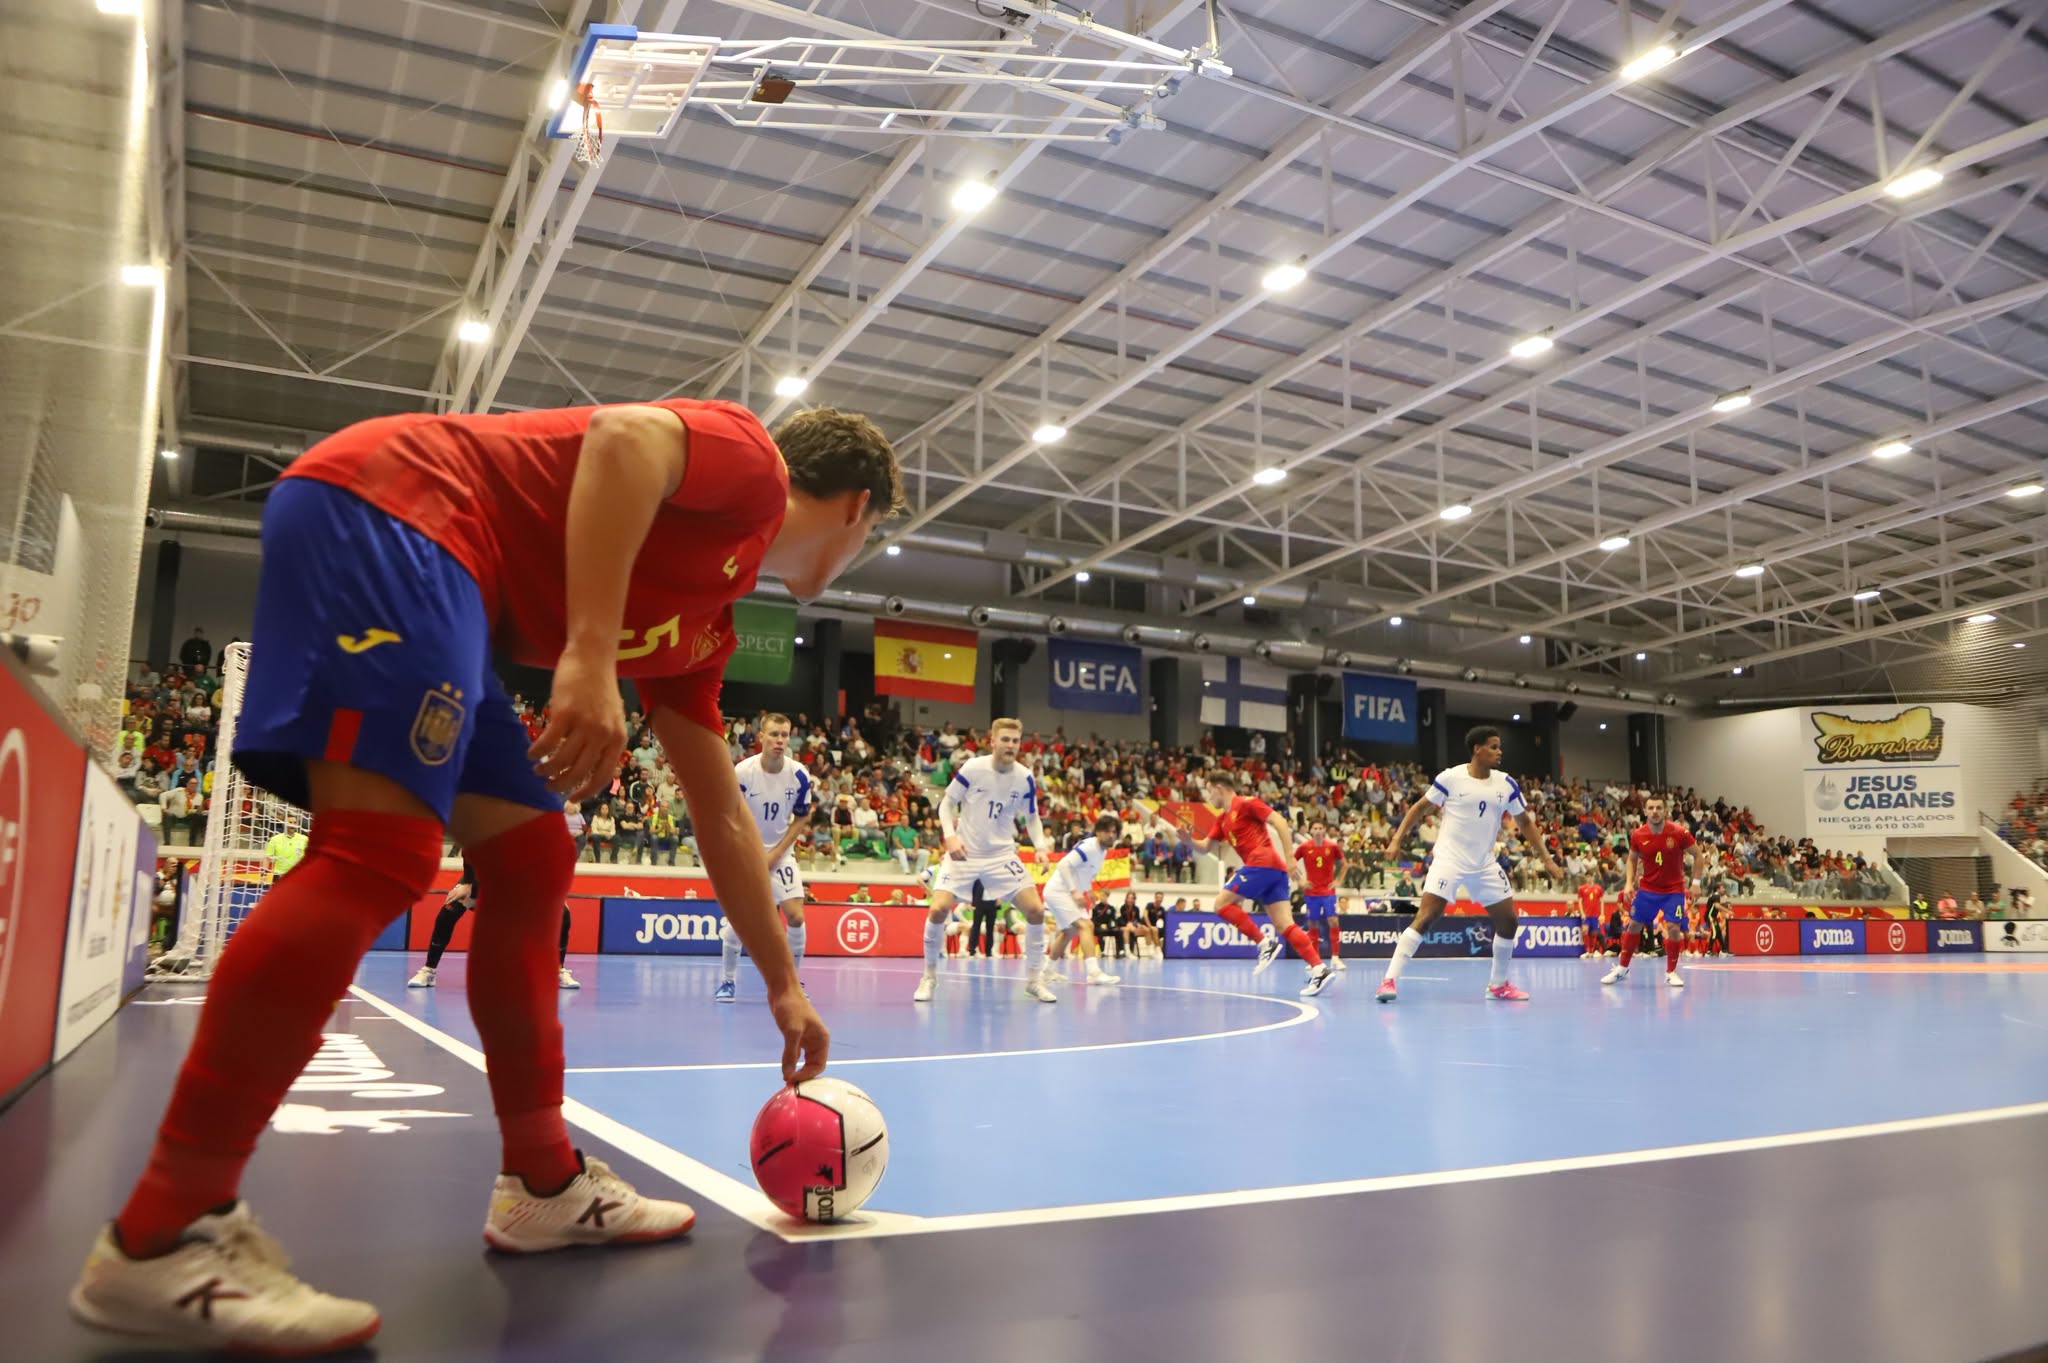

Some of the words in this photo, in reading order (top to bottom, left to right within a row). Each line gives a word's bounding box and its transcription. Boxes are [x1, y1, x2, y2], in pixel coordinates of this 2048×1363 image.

[1054, 659, 1137, 694] UEFA
[1354, 694, 1406, 723] FIFA
[1822, 734, 1941, 760] Borrascas
[1845, 774, 1918, 793] JESUS
[988, 800, 1004, 819] 13
[1478, 800, 1487, 818] 9
[1844, 791, 1956, 810] CABANES
[763, 801, 779, 821] 19
[1818, 815, 1871, 823] RIEGOS
[1874, 814, 1956, 822] APLICADOS
[1655, 851, 1663, 866] 4
[776, 866, 793, 886] 19
[1004, 860, 1024, 876] 13
[1675, 904, 1683, 920] 4
[847, 919, 869, 929] RF
[847, 932, 869, 942] EF
[1363, 930, 1402, 944] FUTSA
